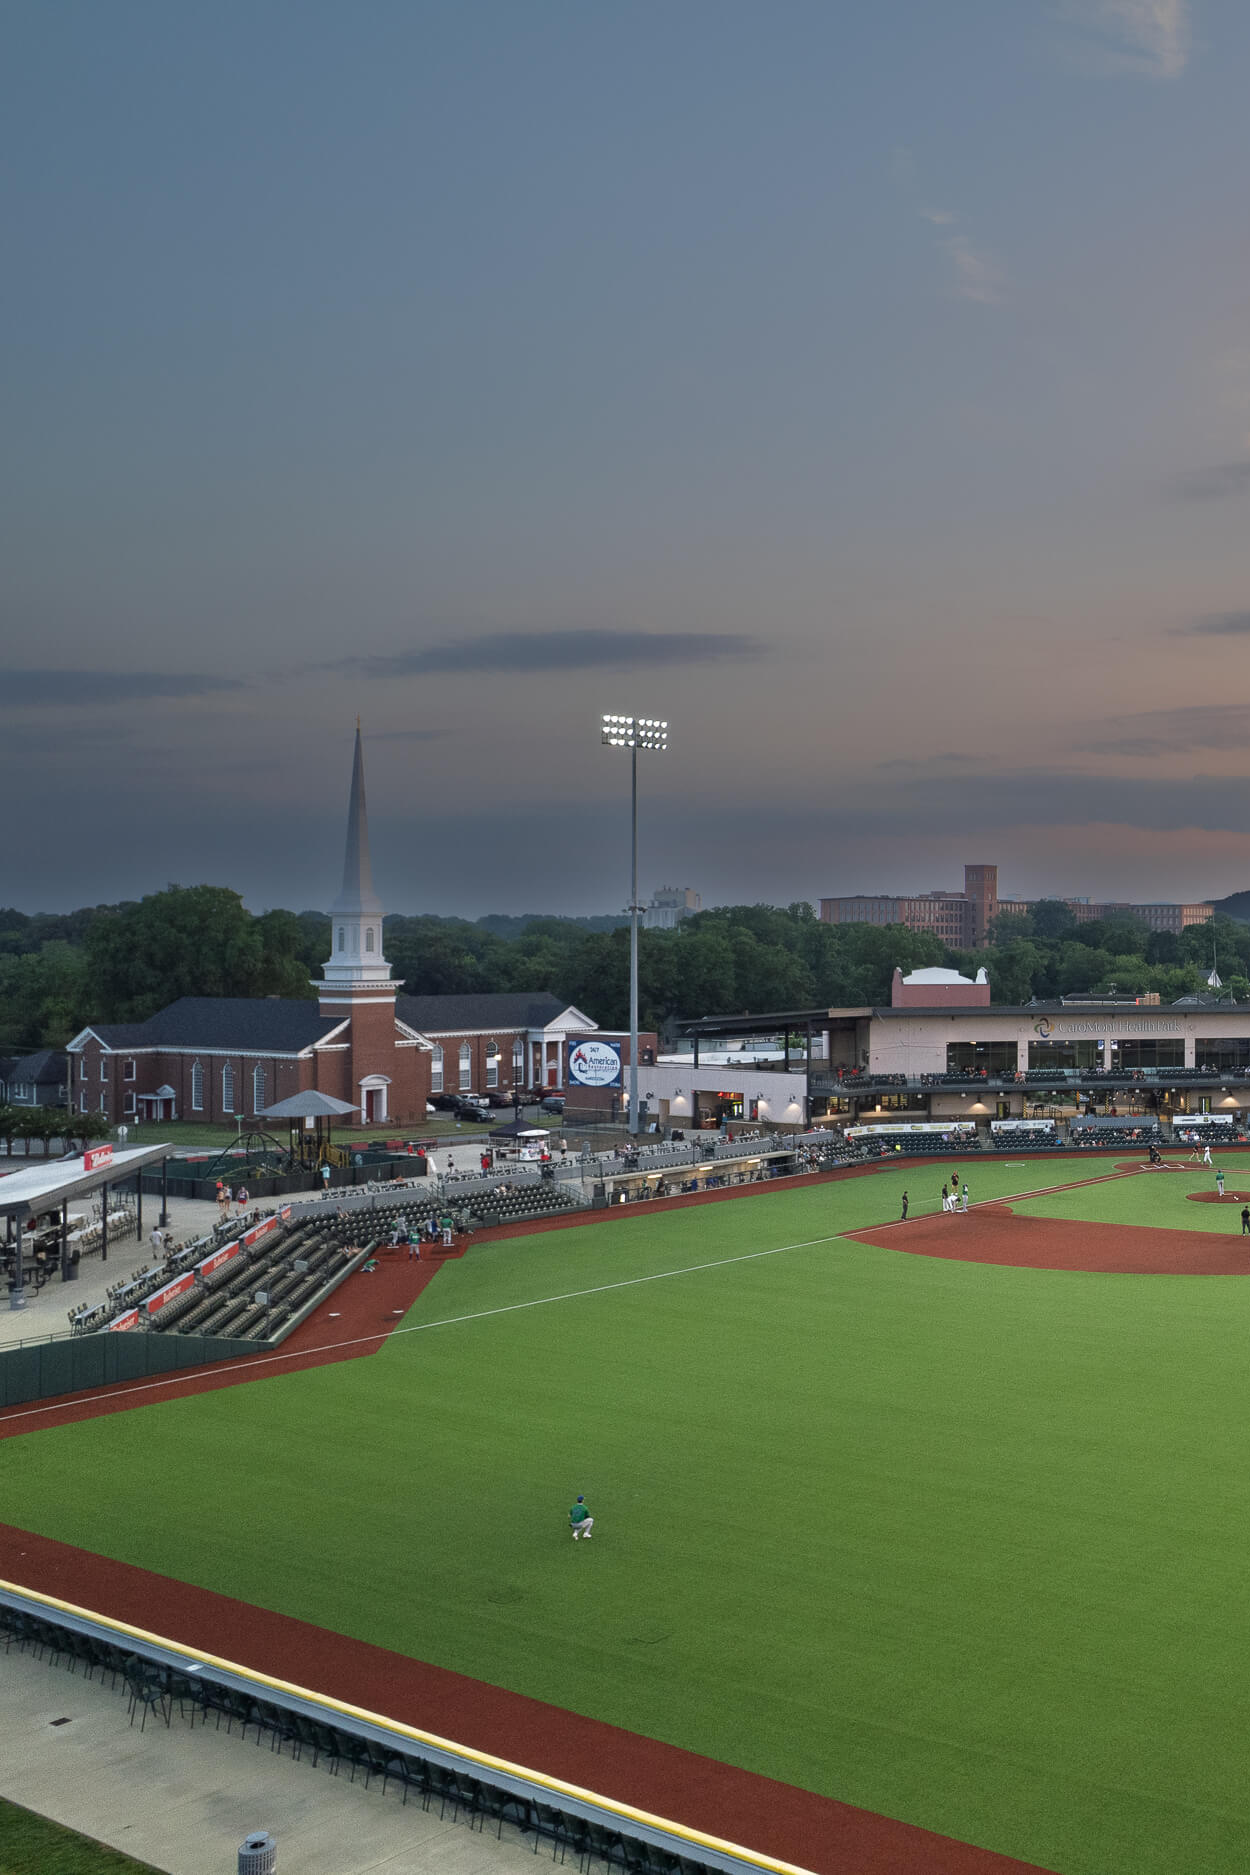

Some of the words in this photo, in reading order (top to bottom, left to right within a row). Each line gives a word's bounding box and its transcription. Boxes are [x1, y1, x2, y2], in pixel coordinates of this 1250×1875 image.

[1058, 1020, 1116, 1033] CaroMont
[1118, 1019, 1156, 1033] Health
[1157, 1019, 1182, 1032] Park
[589, 1056, 618, 1066] American
